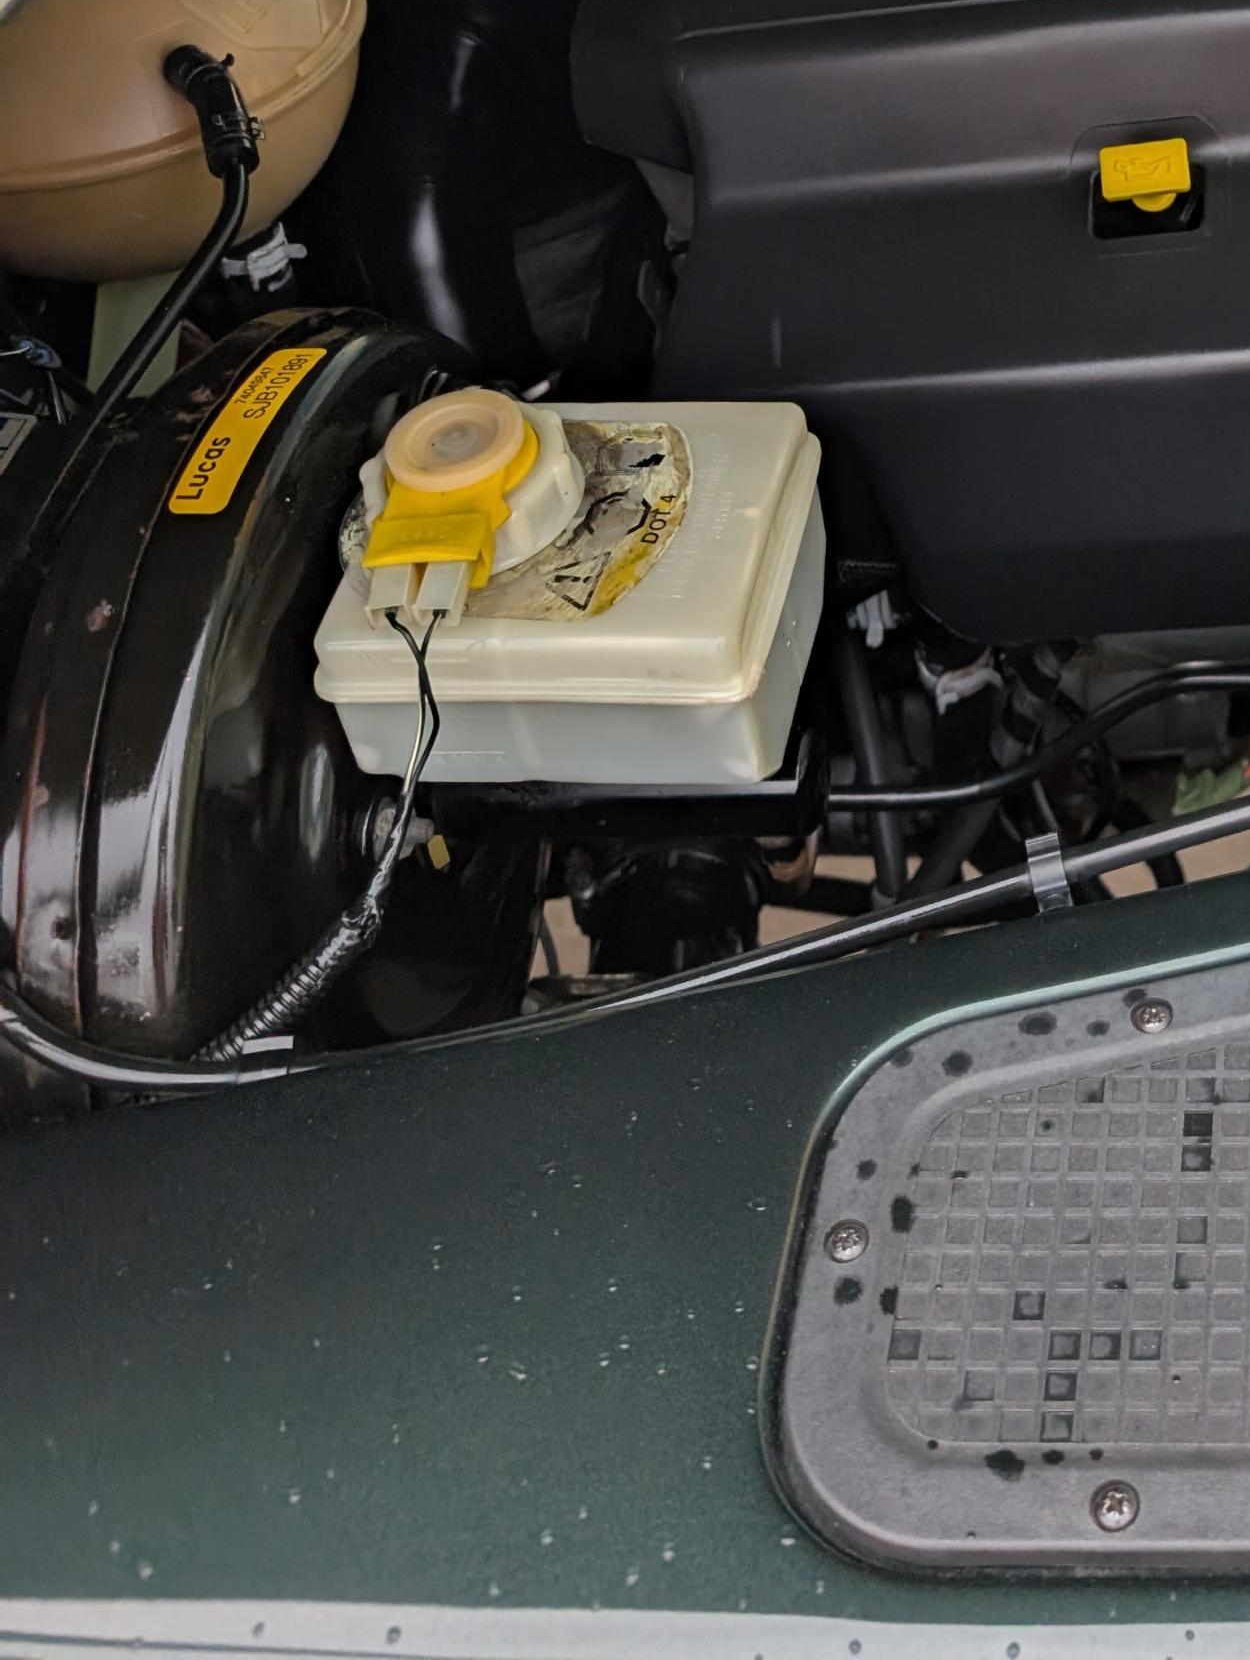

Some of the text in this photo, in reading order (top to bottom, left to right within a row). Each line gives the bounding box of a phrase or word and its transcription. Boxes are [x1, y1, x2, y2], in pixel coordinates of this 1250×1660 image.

[242, 354, 313, 419] SJB101891
[176, 436, 231, 500] Lucas
[640, 494, 677, 544] DOT 4
